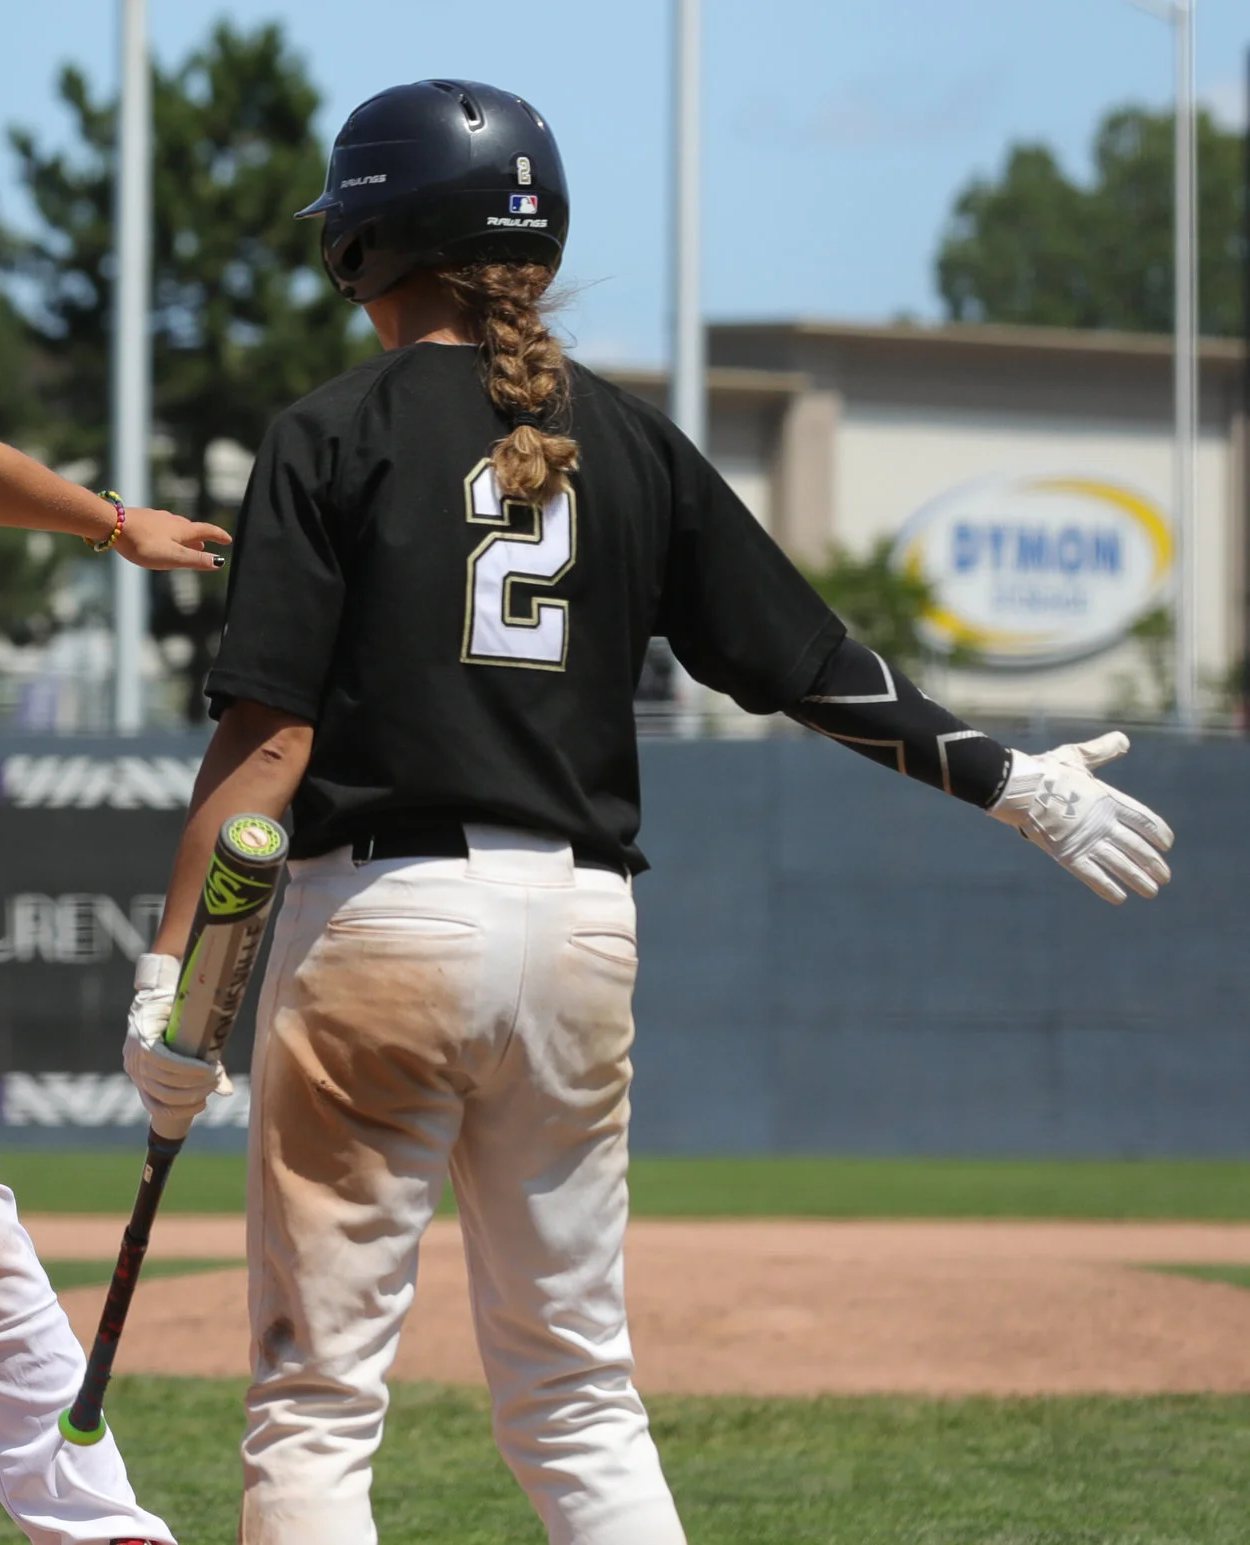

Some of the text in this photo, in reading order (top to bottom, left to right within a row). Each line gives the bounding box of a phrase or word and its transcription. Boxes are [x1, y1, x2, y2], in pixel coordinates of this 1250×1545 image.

[517, 156, 531, 185] 2
[487, 216, 548, 228] RAWLINGS
[461, 457, 577, 672] 2
[951, 520, 1124, 577] DYMON
